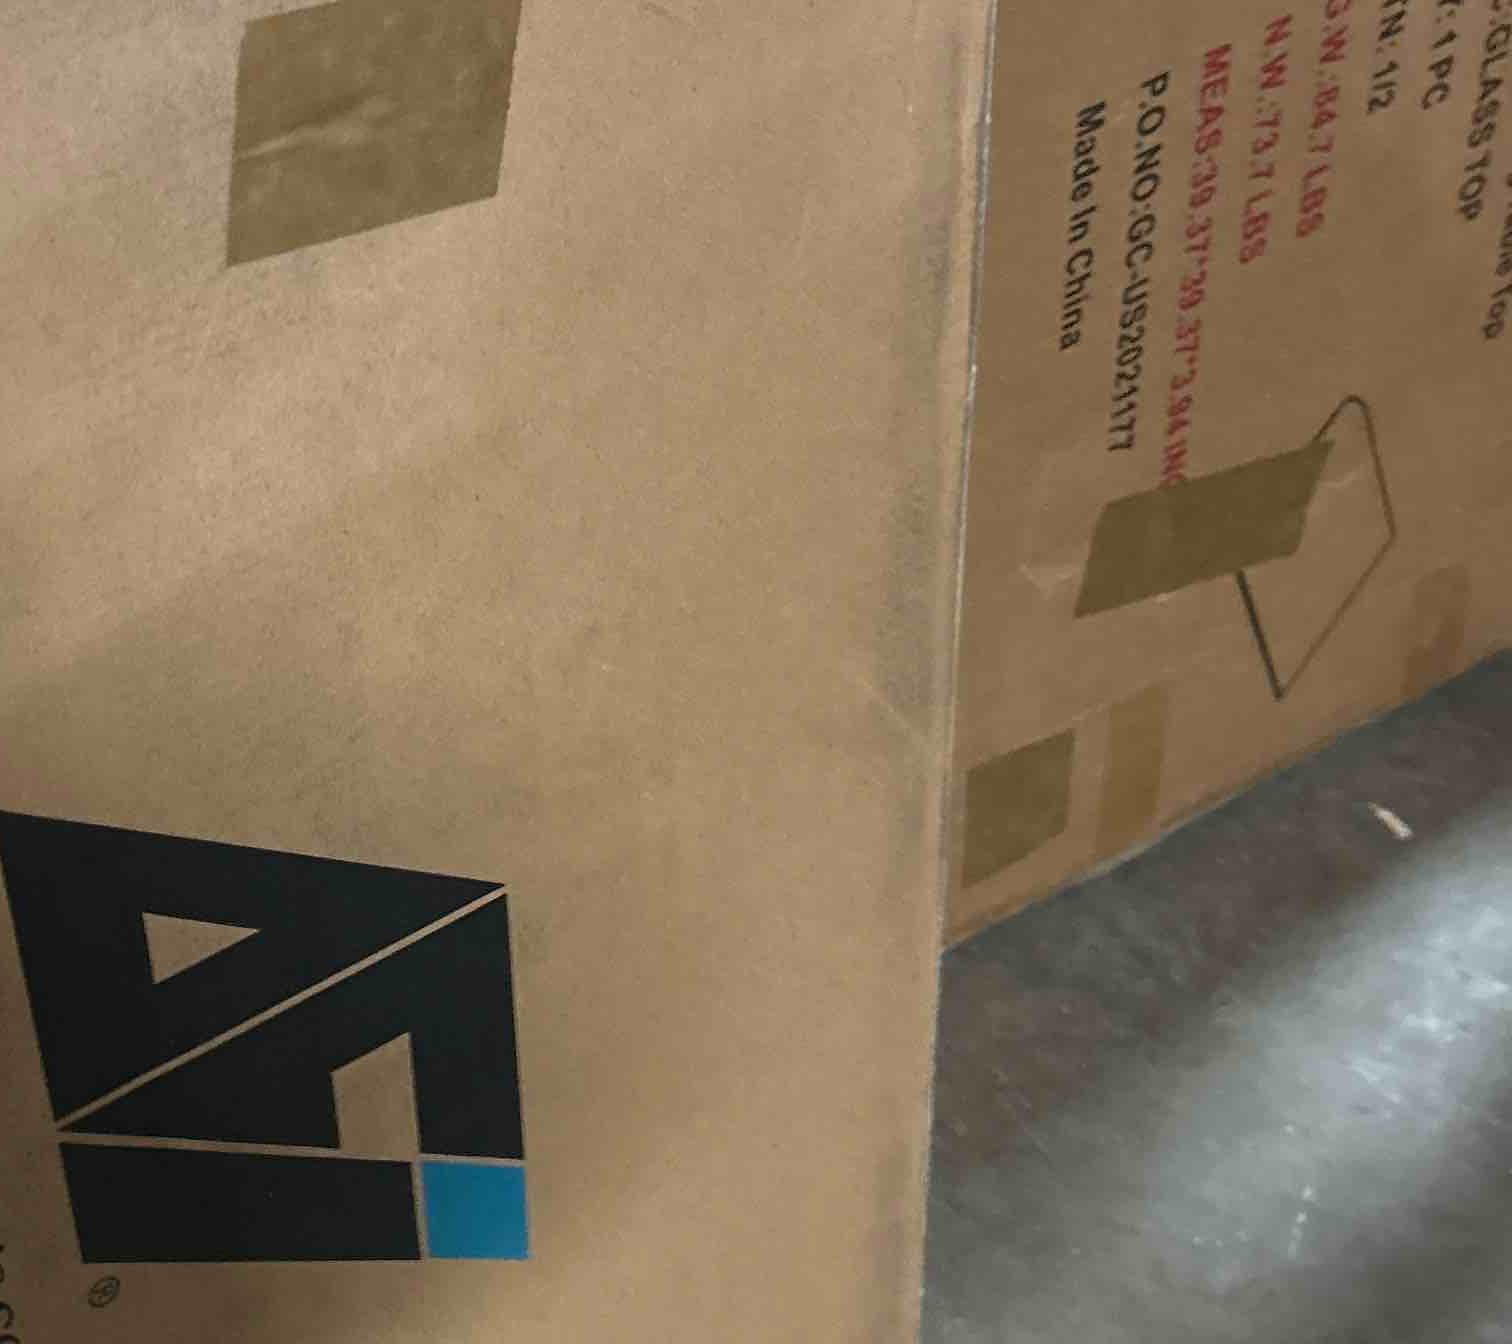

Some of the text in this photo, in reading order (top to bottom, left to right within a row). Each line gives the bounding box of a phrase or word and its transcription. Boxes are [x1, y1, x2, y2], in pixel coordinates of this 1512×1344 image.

[1420, 56, 1455, 111] PC
[1058, 100, 1108, 353] Made In China
[1237, 195, 1274, 265] LBS
[1294, 163, 1332, 238] LBS
